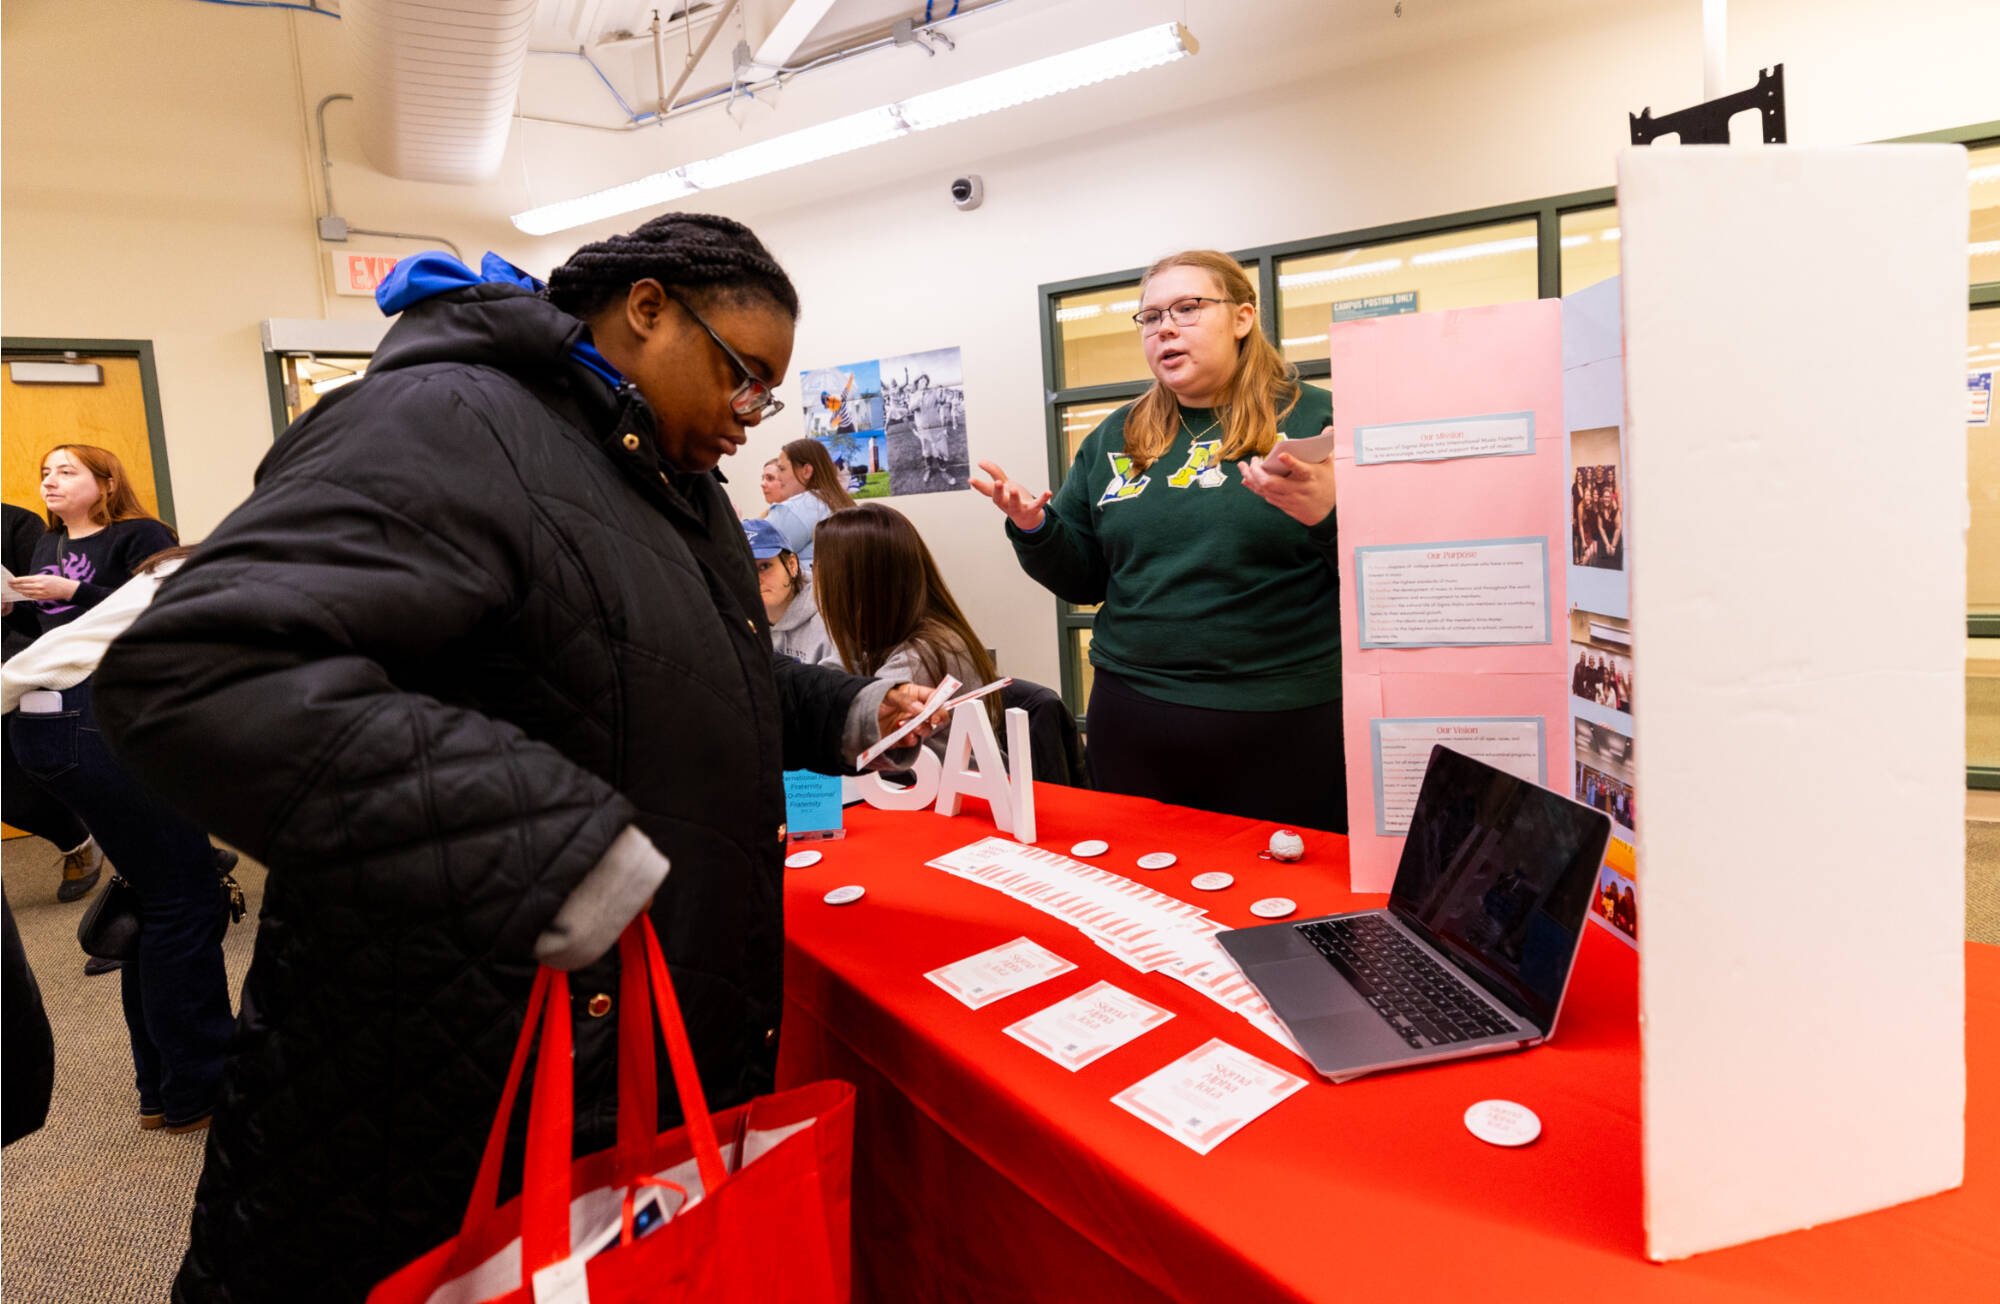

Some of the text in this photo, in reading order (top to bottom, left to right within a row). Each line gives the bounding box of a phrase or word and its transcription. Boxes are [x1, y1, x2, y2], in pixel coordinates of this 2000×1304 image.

[347, 255, 398, 290] EXIT
[1334, 292, 1415, 312] CAMPUS POSTING ONLY
[1426, 551, 1478, 560] Our Purpose
[1453, 726, 1479, 734] Vision
[1202, 1072, 1239, 1094] Alpha
[1215, 1063, 1252, 1087] Sigma
